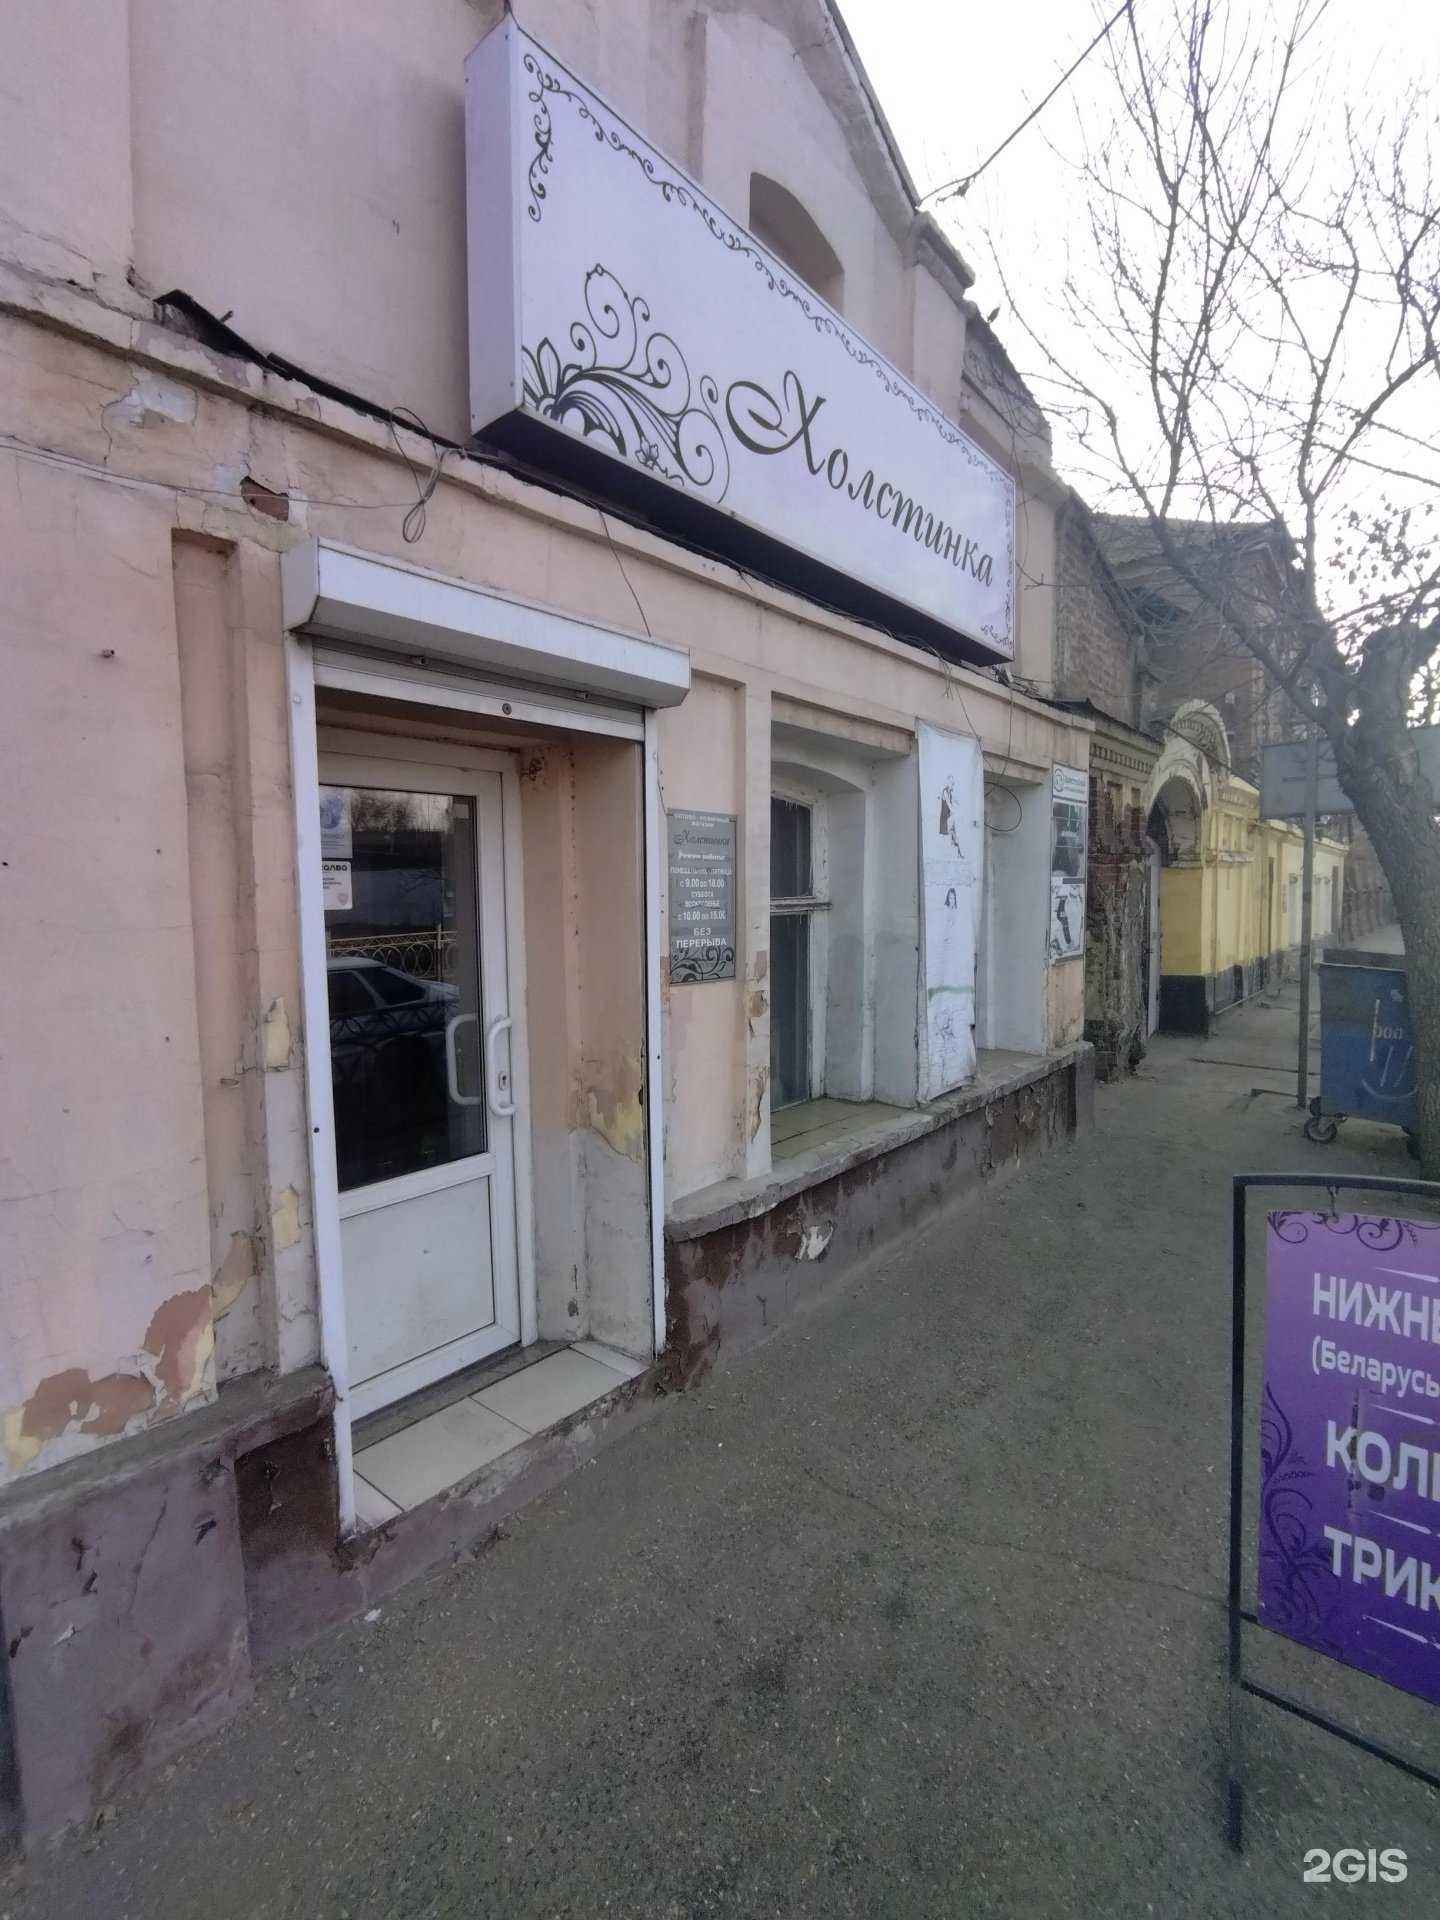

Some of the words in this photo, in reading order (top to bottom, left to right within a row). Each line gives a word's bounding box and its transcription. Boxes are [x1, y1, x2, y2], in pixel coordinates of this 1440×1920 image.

[726, 370, 993, 587] Холстинка
[693, 927, 712, 936] БЕЗ
[676, 937, 728, 949] ПЕРЕРЫВА
